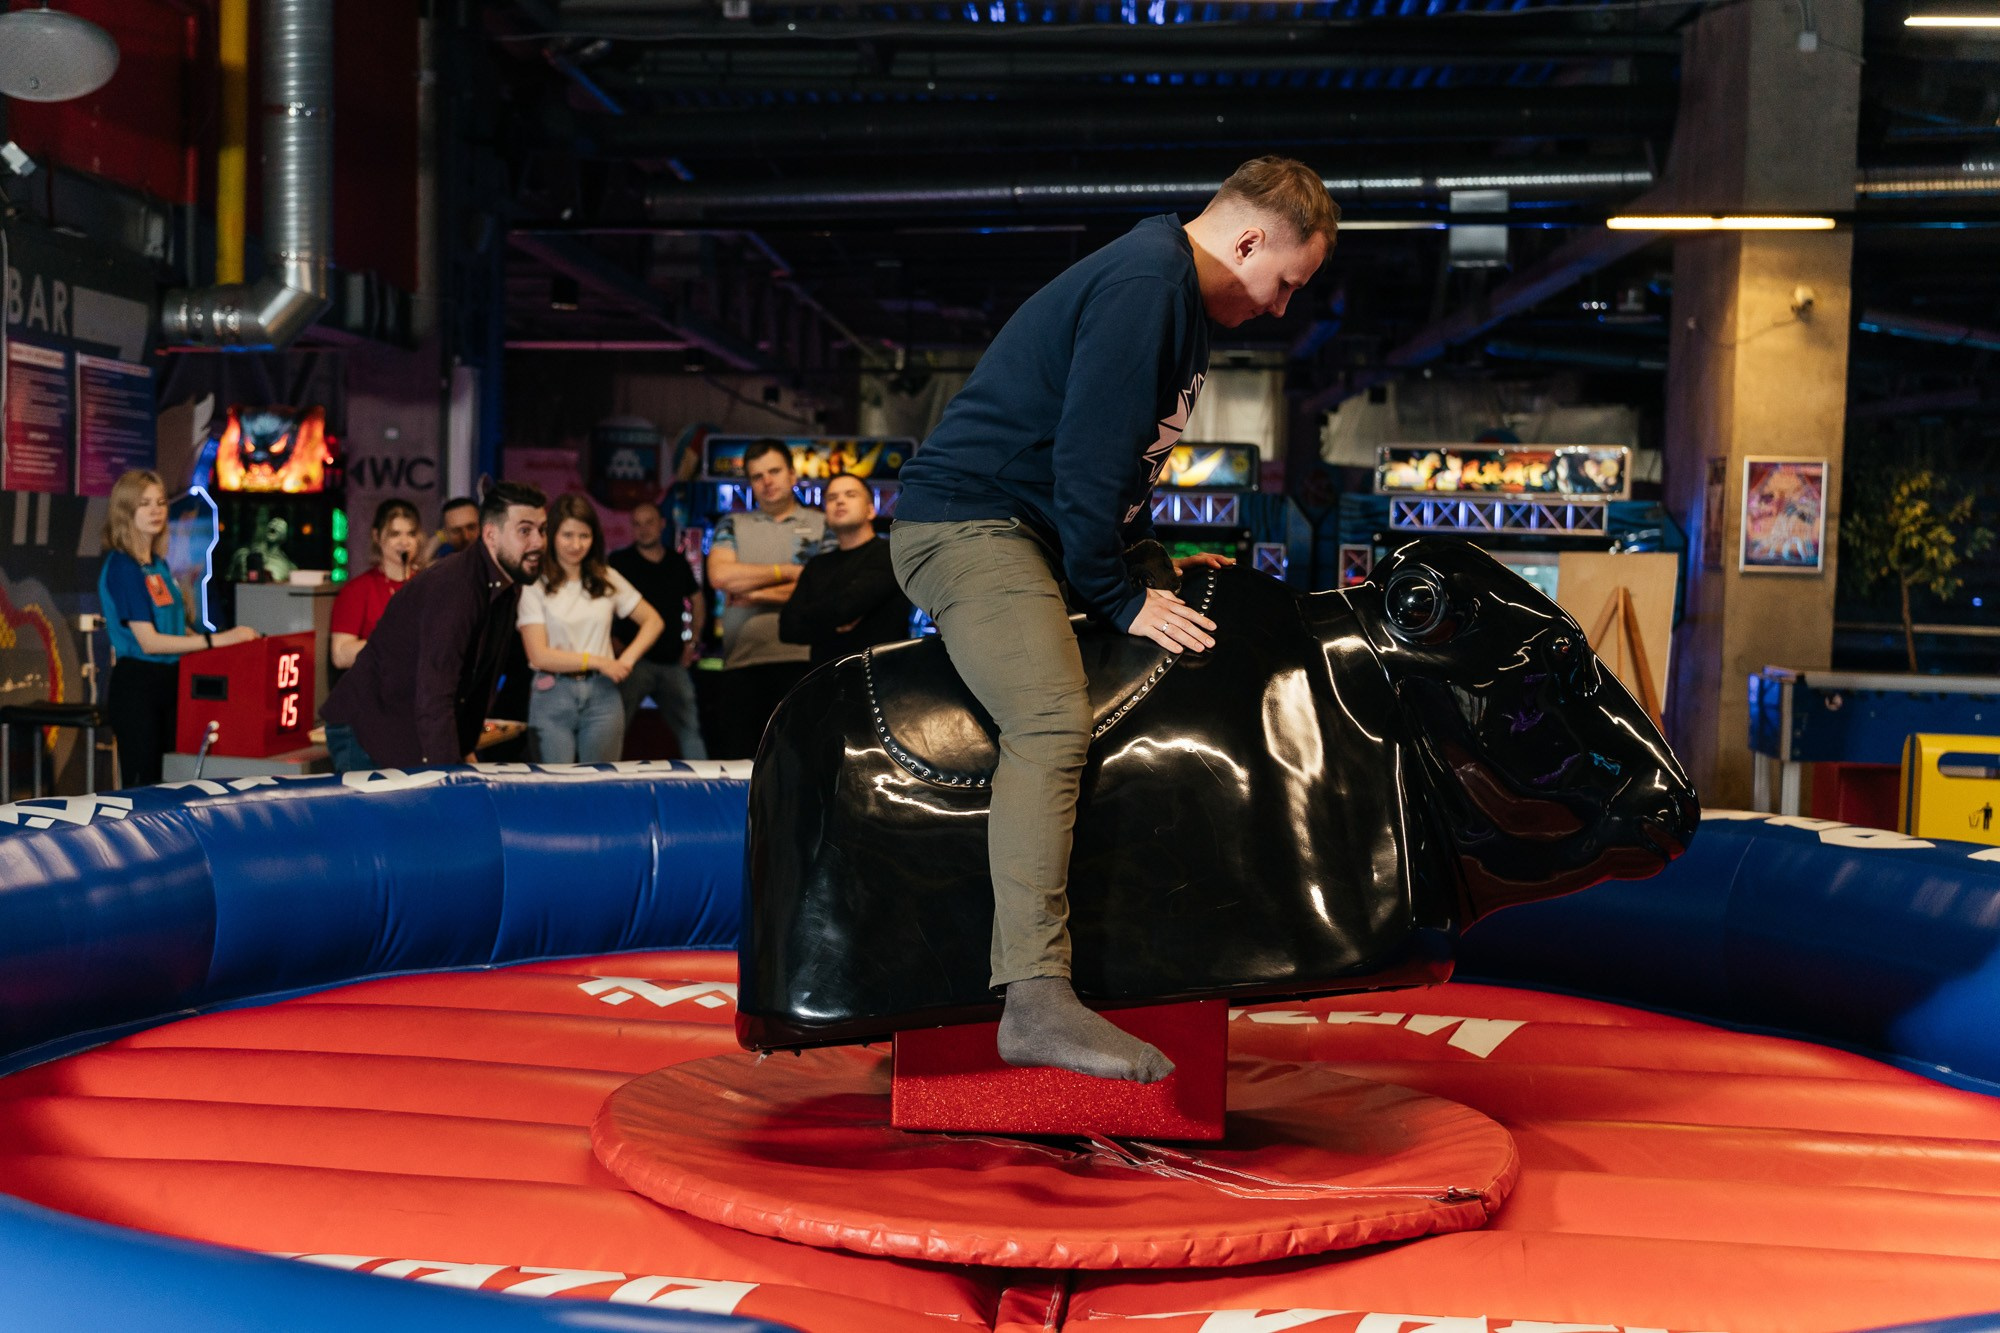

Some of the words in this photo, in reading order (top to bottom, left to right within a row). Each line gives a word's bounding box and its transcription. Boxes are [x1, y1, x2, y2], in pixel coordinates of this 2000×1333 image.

[7, 266, 69, 336] BAR
[367, 456, 434, 490] WC
[277, 653, 300, 689] 05
[280, 693, 299, 727] 15
